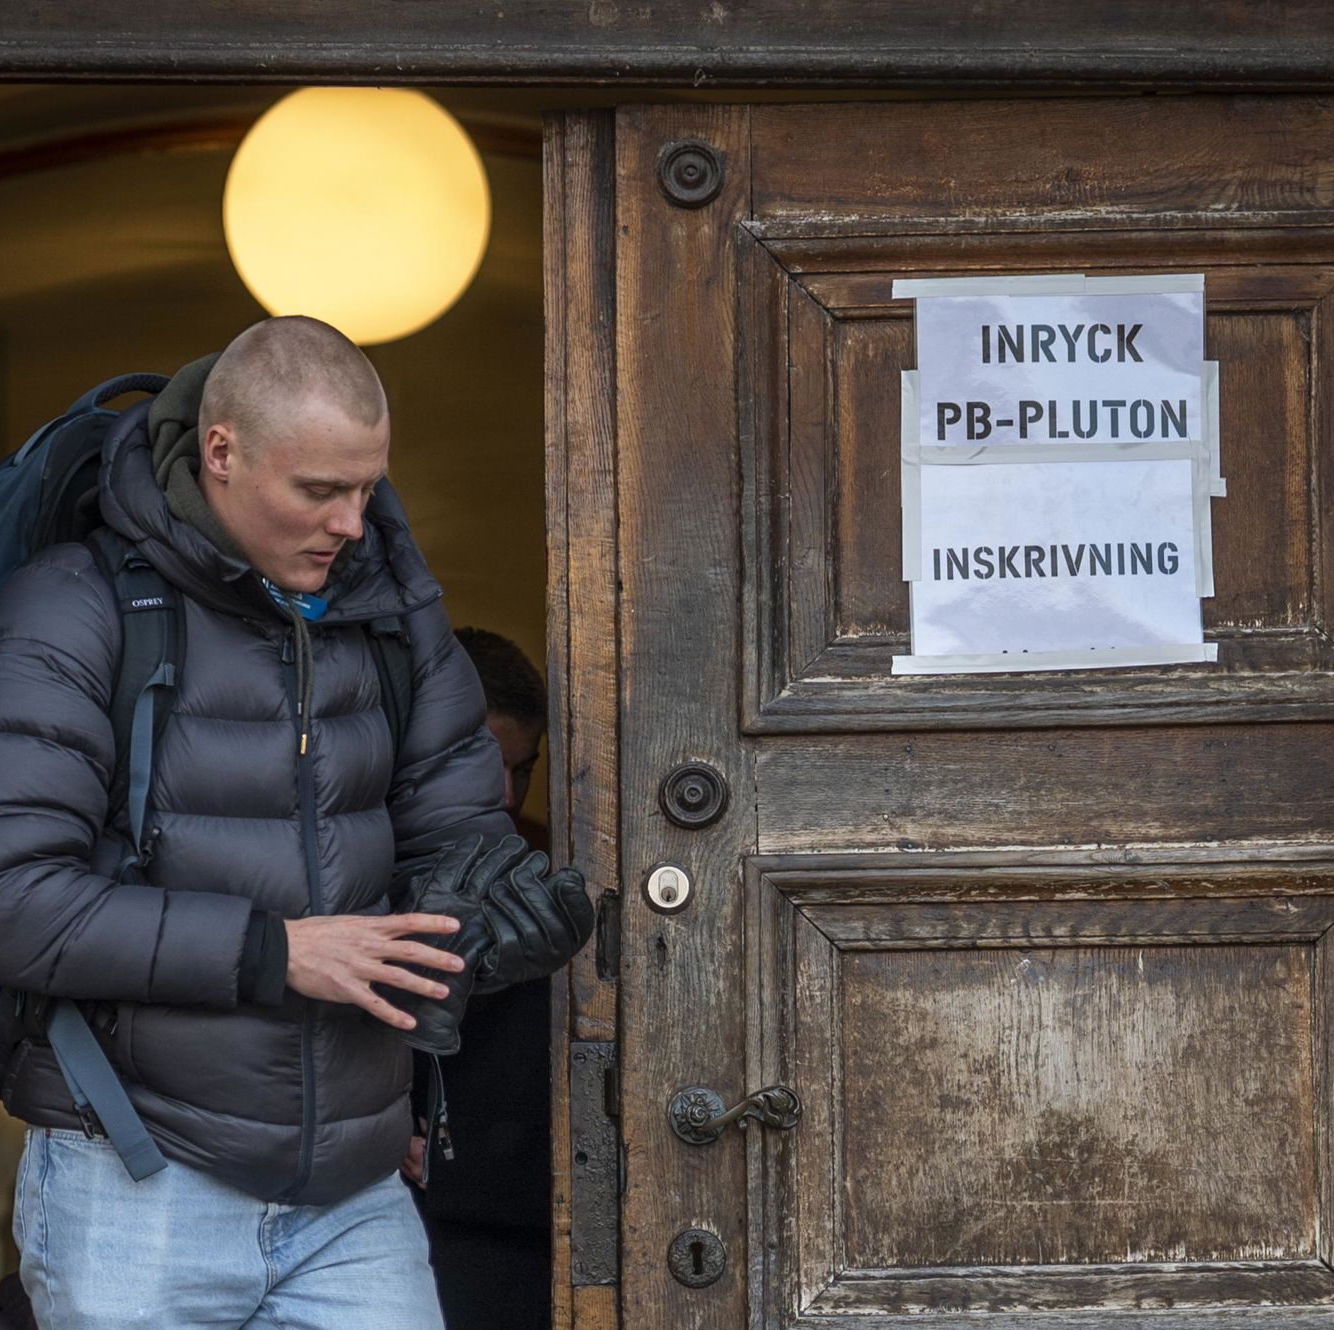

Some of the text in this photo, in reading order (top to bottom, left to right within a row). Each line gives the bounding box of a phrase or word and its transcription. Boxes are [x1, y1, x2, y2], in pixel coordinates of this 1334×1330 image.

[981, 323, 1144, 364] INRYCK
[936, 399, 1188, 441] PB-PLUTON
[933, 541, 1180, 581] INSKRIVNING
[132, 597, 163, 607] OSPREY
